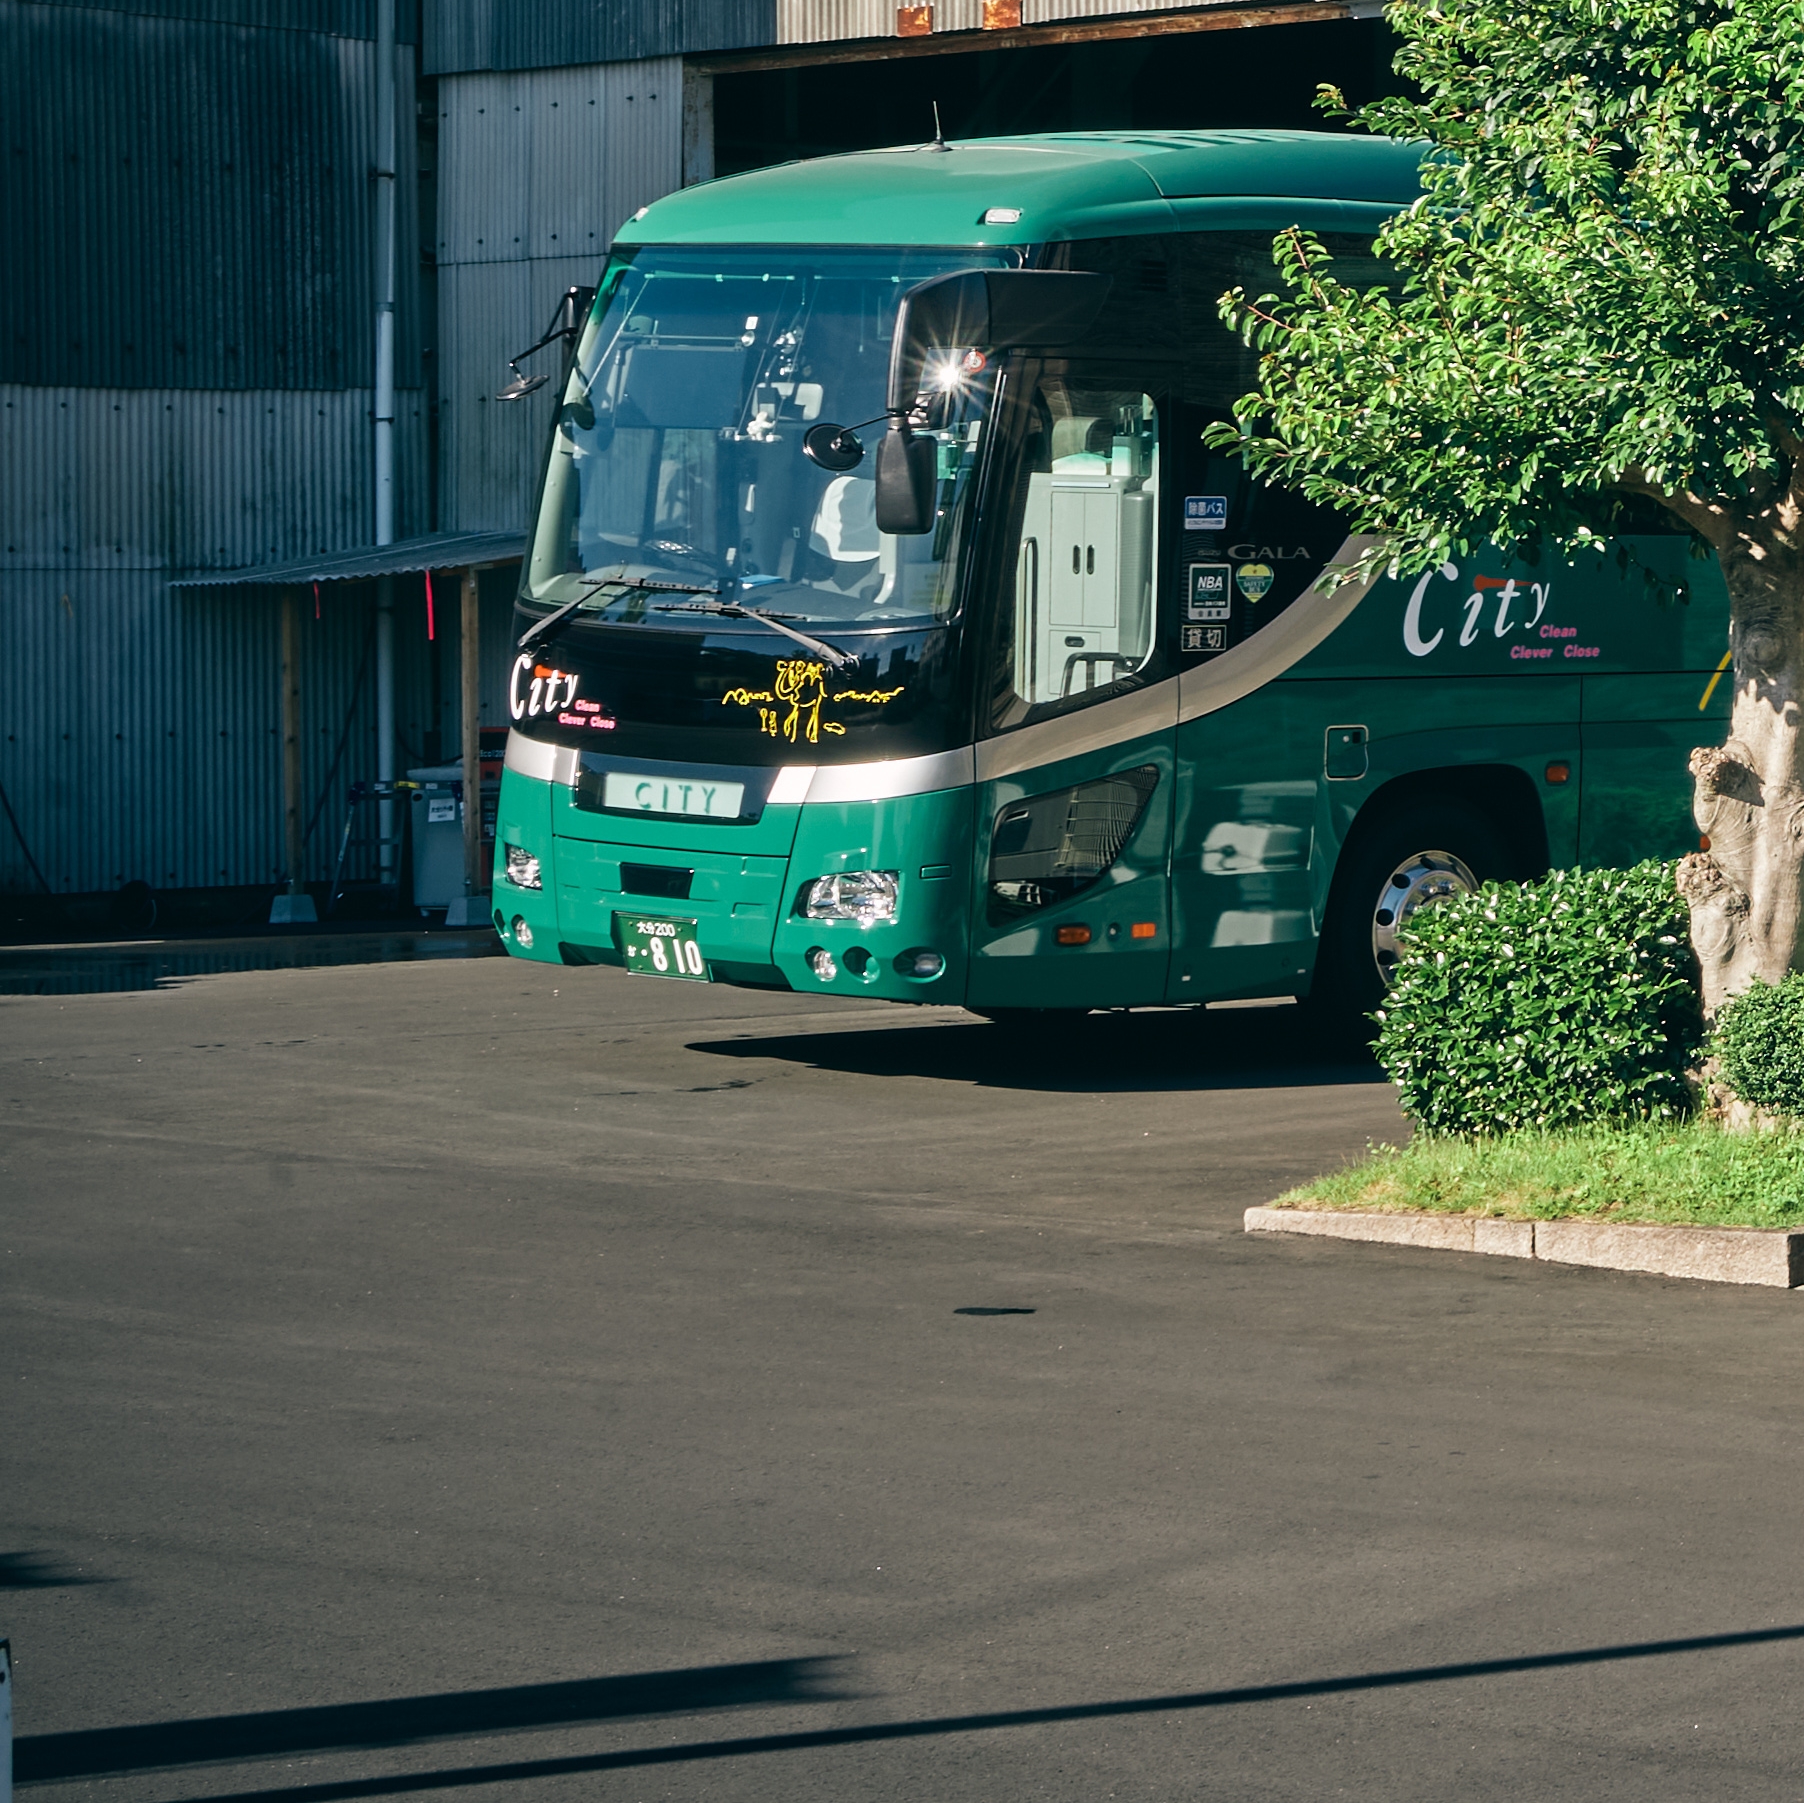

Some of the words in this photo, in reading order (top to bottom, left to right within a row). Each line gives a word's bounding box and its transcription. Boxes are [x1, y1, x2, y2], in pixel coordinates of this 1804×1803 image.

[1227, 544, 1311, 559] GALA
[1197, 576, 1223, 590] NBA
[1403, 561, 1550, 657] City
[1187, 629, 1222, 648] 貸切
[1539, 624, 1578, 638] Clean
[1510, 646, 1553, 659] Clever
[1563, 644, 1600, 658] Close
[509, 653, 579, 721] City
[635, 782, 716, 814] CITY
